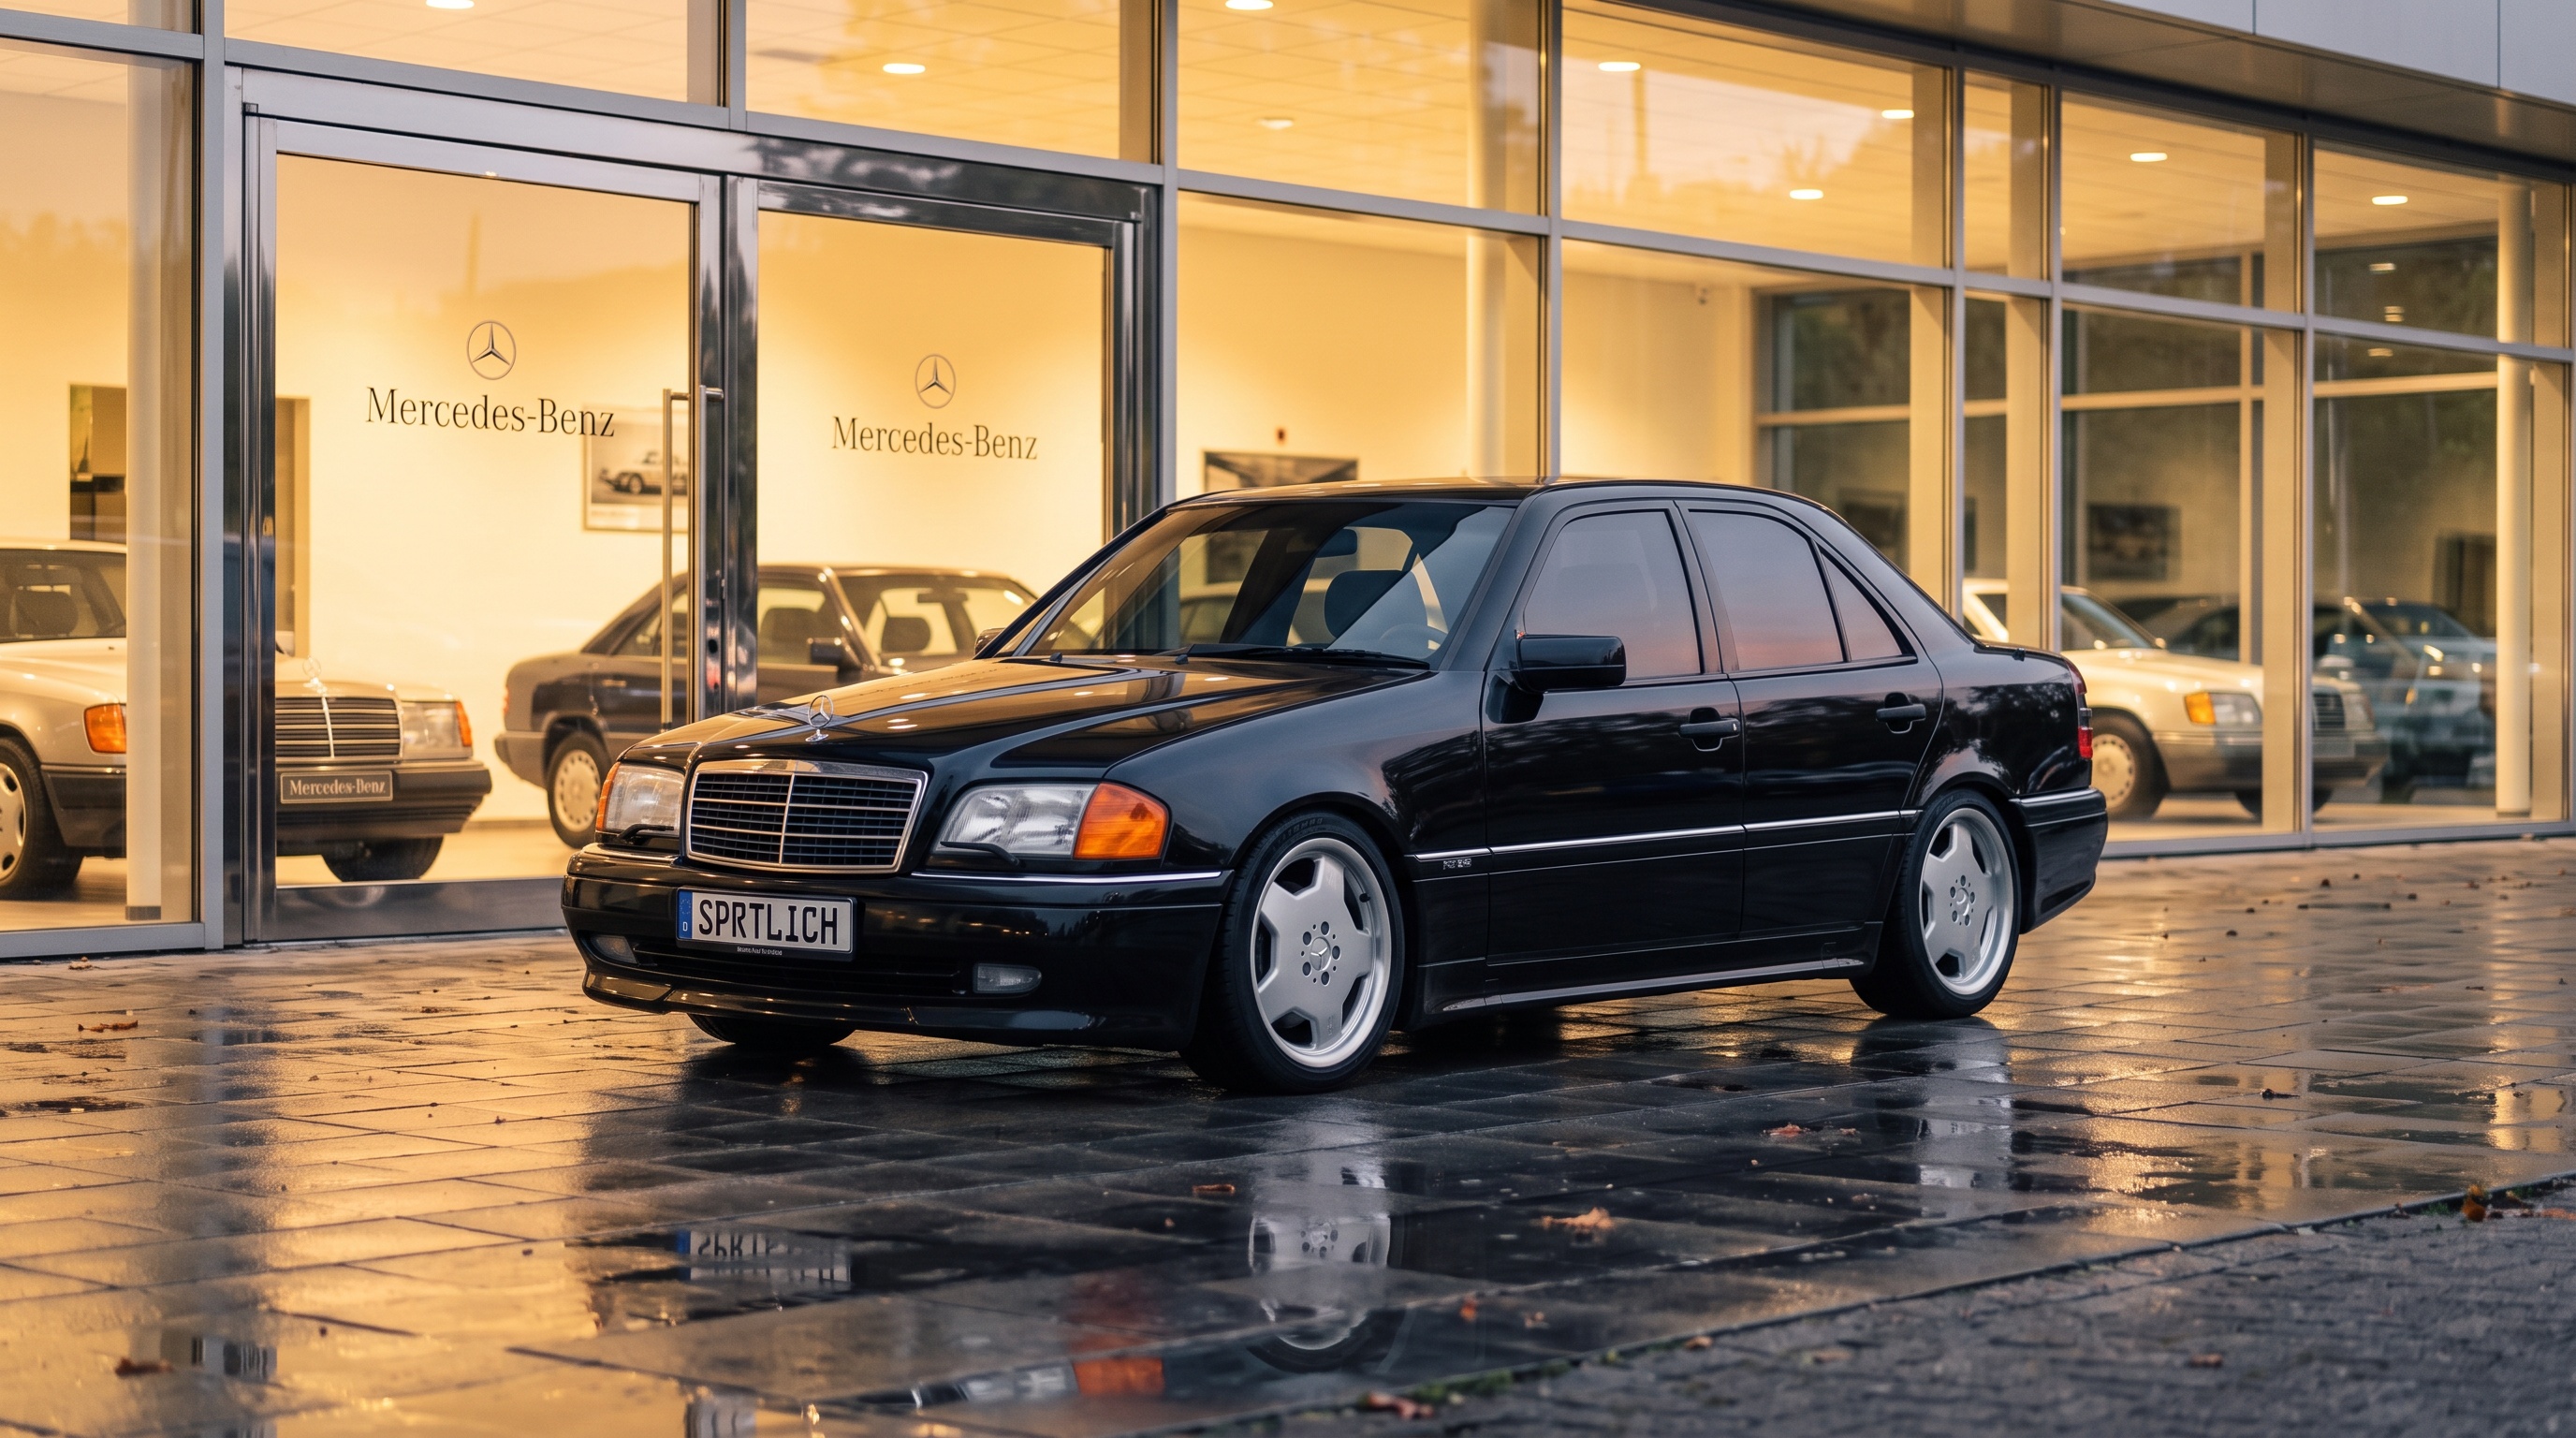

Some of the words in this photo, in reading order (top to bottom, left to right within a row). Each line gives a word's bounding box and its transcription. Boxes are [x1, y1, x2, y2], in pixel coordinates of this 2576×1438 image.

[366, 387, 615, 437] Mercedes-Benz
[831, 416, 1037, 460] Mercedes-Benz
[682, 921, 688, 932] D
[698, 899, 838, 945] SPRTLICH
